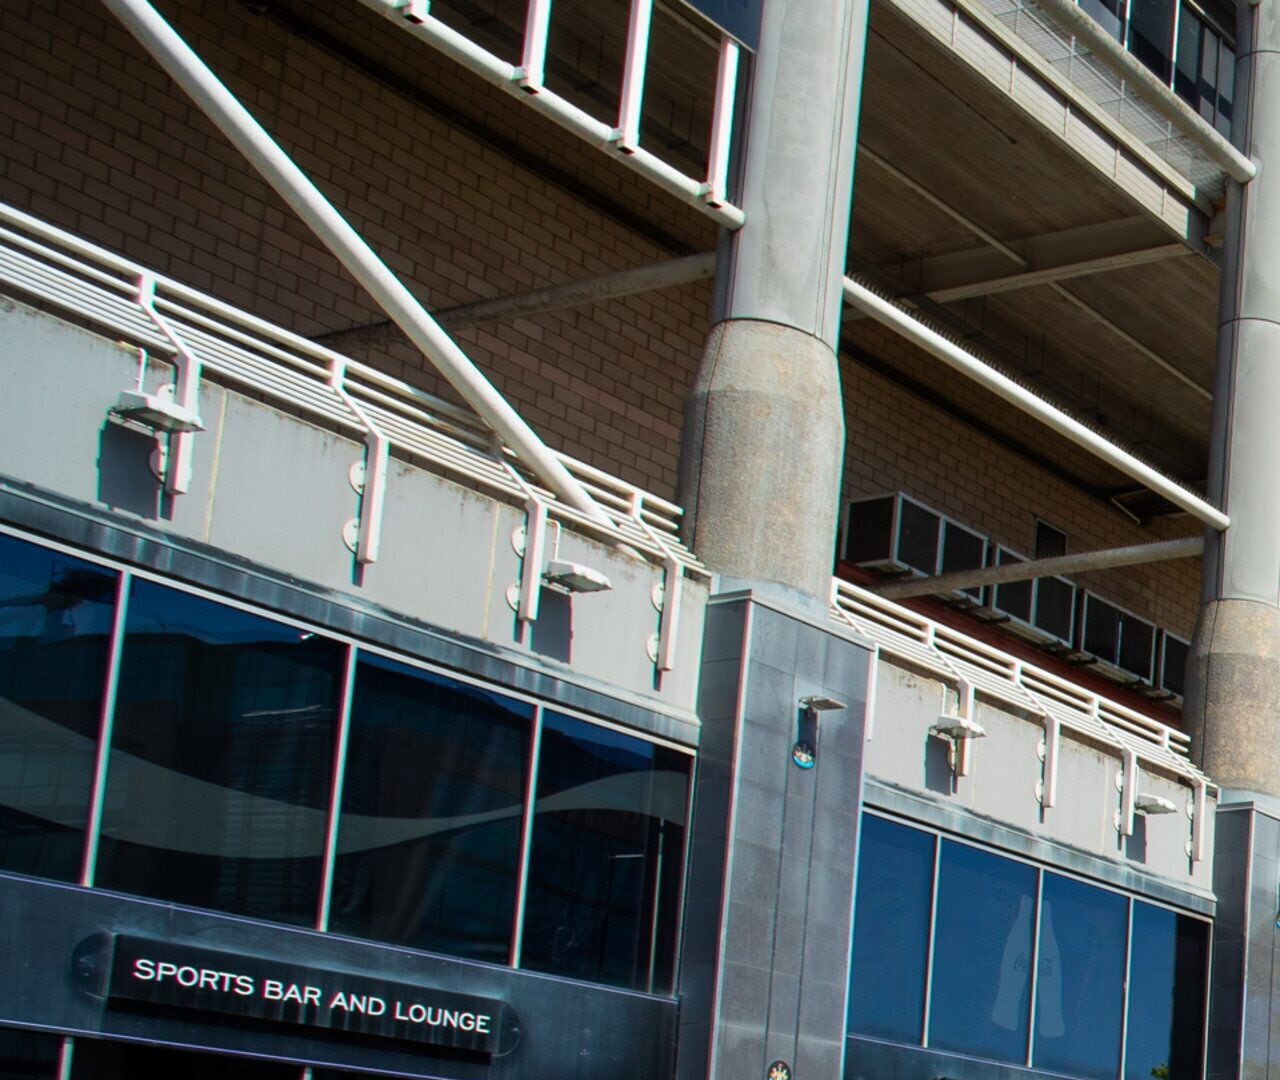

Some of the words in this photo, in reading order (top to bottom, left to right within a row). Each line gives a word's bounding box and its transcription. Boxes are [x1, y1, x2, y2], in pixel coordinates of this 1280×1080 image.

[133, 958, 255, 996] SPORTS
[263, 979, 322, 1007] BAR
[330, 991, 386, 1016] AND
[394, 1001, 491, 1034] LOUNGE
